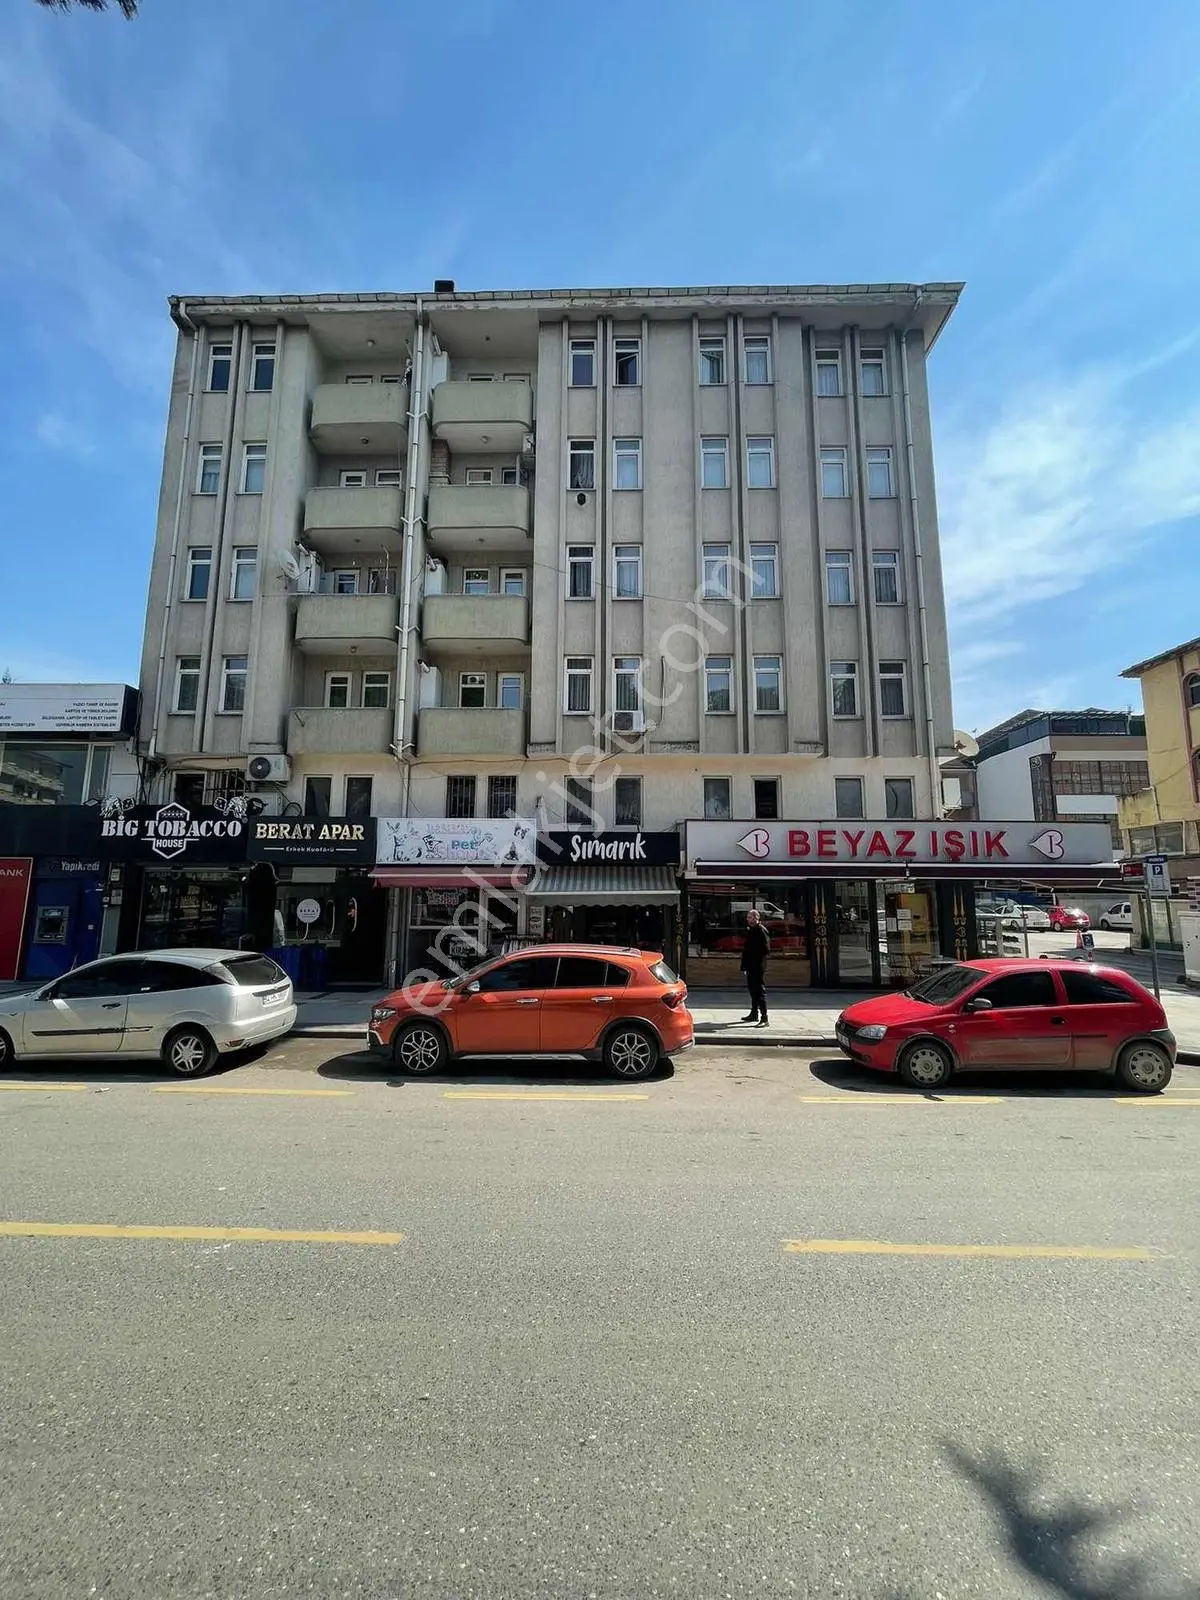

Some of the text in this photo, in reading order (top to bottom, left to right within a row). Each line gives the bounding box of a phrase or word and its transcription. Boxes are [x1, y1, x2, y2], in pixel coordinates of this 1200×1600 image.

[145, 820, 242, 837] TOBACCO
[255, 823, 365, 840] BERAT APAR
[156, 838, 183, 848] HOUSE
[451, 840, 479, 850] Pet
[570, 833, 647, 862] Şımarık
[787, 830, 1009, 861] BEYAZ IŞIK
